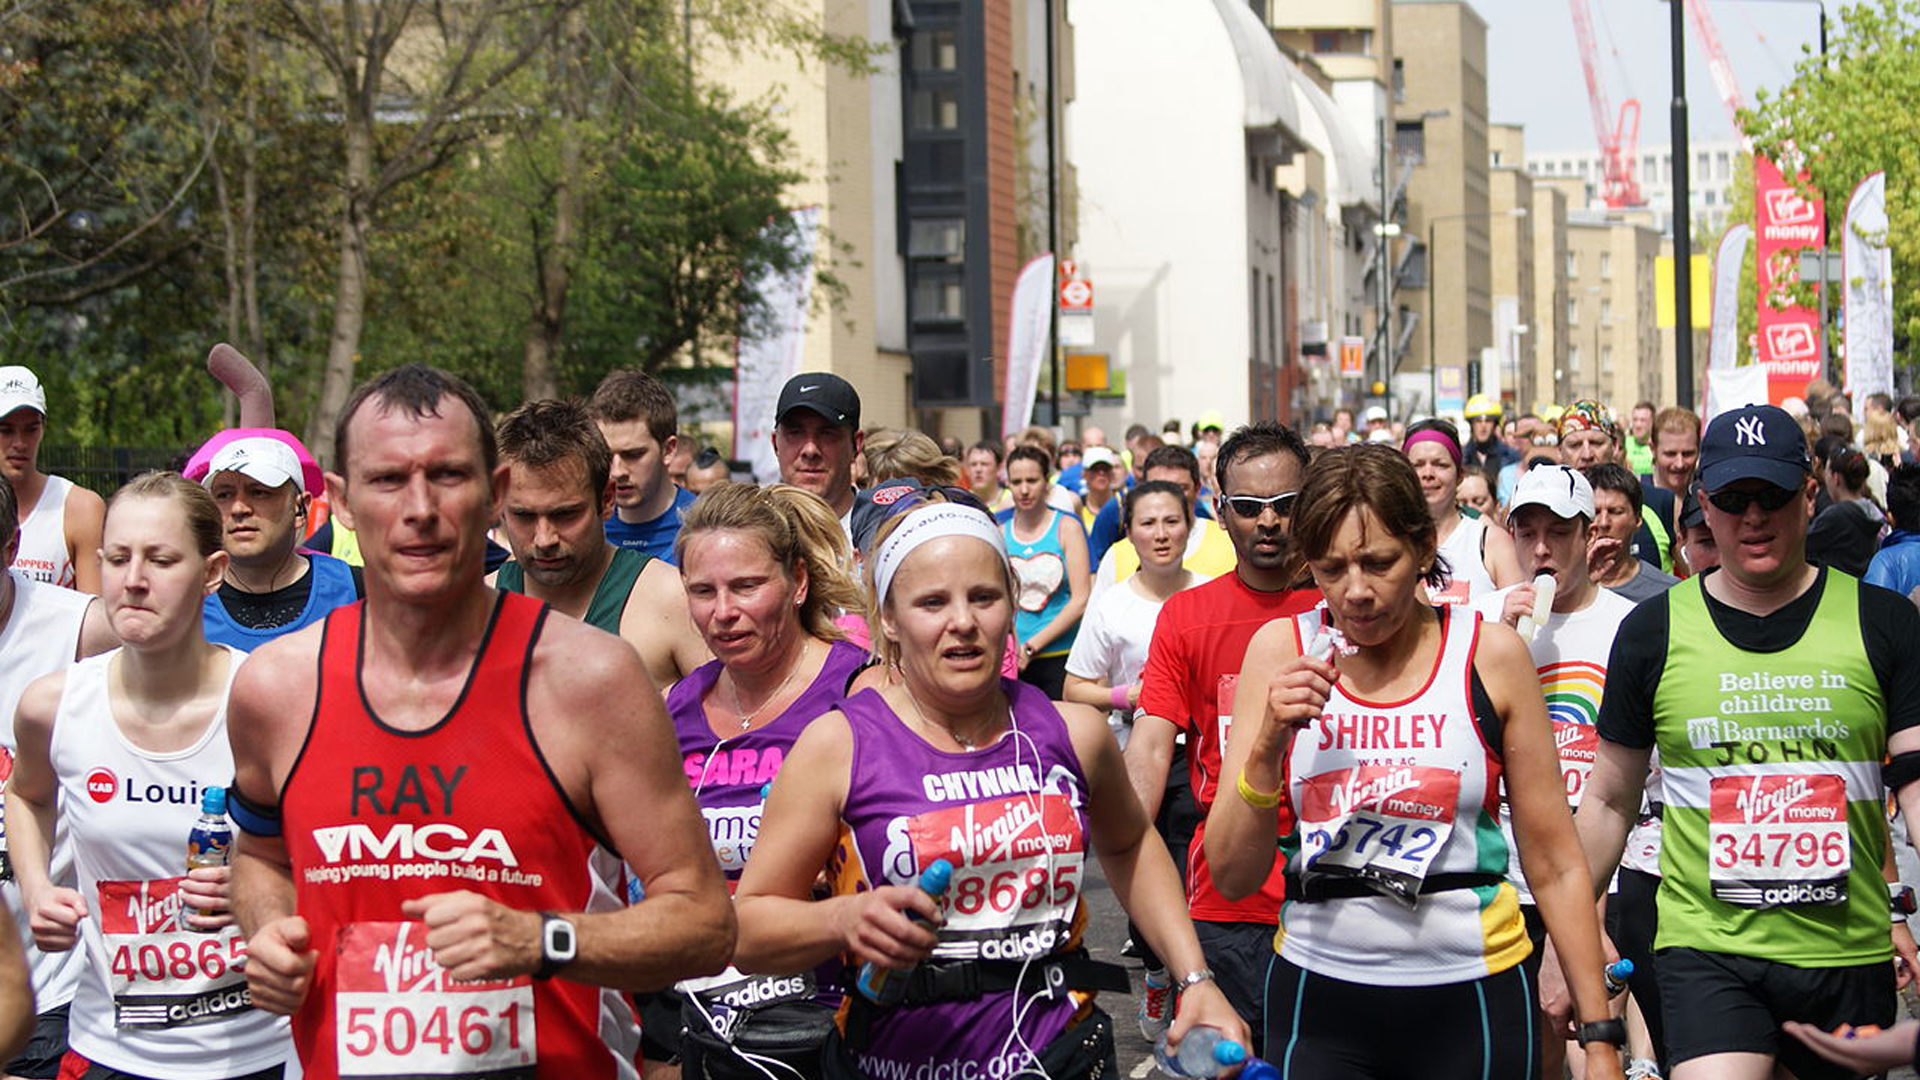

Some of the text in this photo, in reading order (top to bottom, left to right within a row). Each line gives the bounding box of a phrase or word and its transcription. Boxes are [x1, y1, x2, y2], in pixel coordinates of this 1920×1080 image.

[1765, 225, 1819, 242] money
[1765, 360, 1820, 378] money
[1718, 669, 1848, 692] Believe in
[1718, 694, 1833, 715] children
[1319, 713, 1447, 750] SHIRLEY
[1722, 716, 1850, 743] Barnardo's
[683, 747, 784, 787] SARA
[1400, 757, 1417, 766] AC
[1710, 740, 1838, 767] JOHN
[89, 782, 114, 793] KAB
[126, 778, 207, 804] Loui
[350, 765, 468, 817] RAY
[922, 764, 1041, 802] CHYNNA
[1330, 765, 1421, 818] Virgin
[1388, 799, 1444, 818] money
[1735, 774, 1814, 826] Virgin
[1789, 805, 1837, 820] money
[312, 823, 519, 867] YMCA
[950, 800, 1040, 866] Virgin
[1714, 831, 1845, 869] 34796
[342, 863, 391, 881] young
[393, 862, 449, 880] people
[451, 861, 486, 881] build
[487, 869, 498, 880] a
[501, 868, 543, 887] future
[942, 865, 1077, 915] 8685
[1764, 884, 1837, 903] adidas
[112, 936, 247, 983] 40865
[169, 986, 253, 1022] adidas
[724, 977, 805, 1007] adidas
[345, 1001, 521, 1057] 50461
